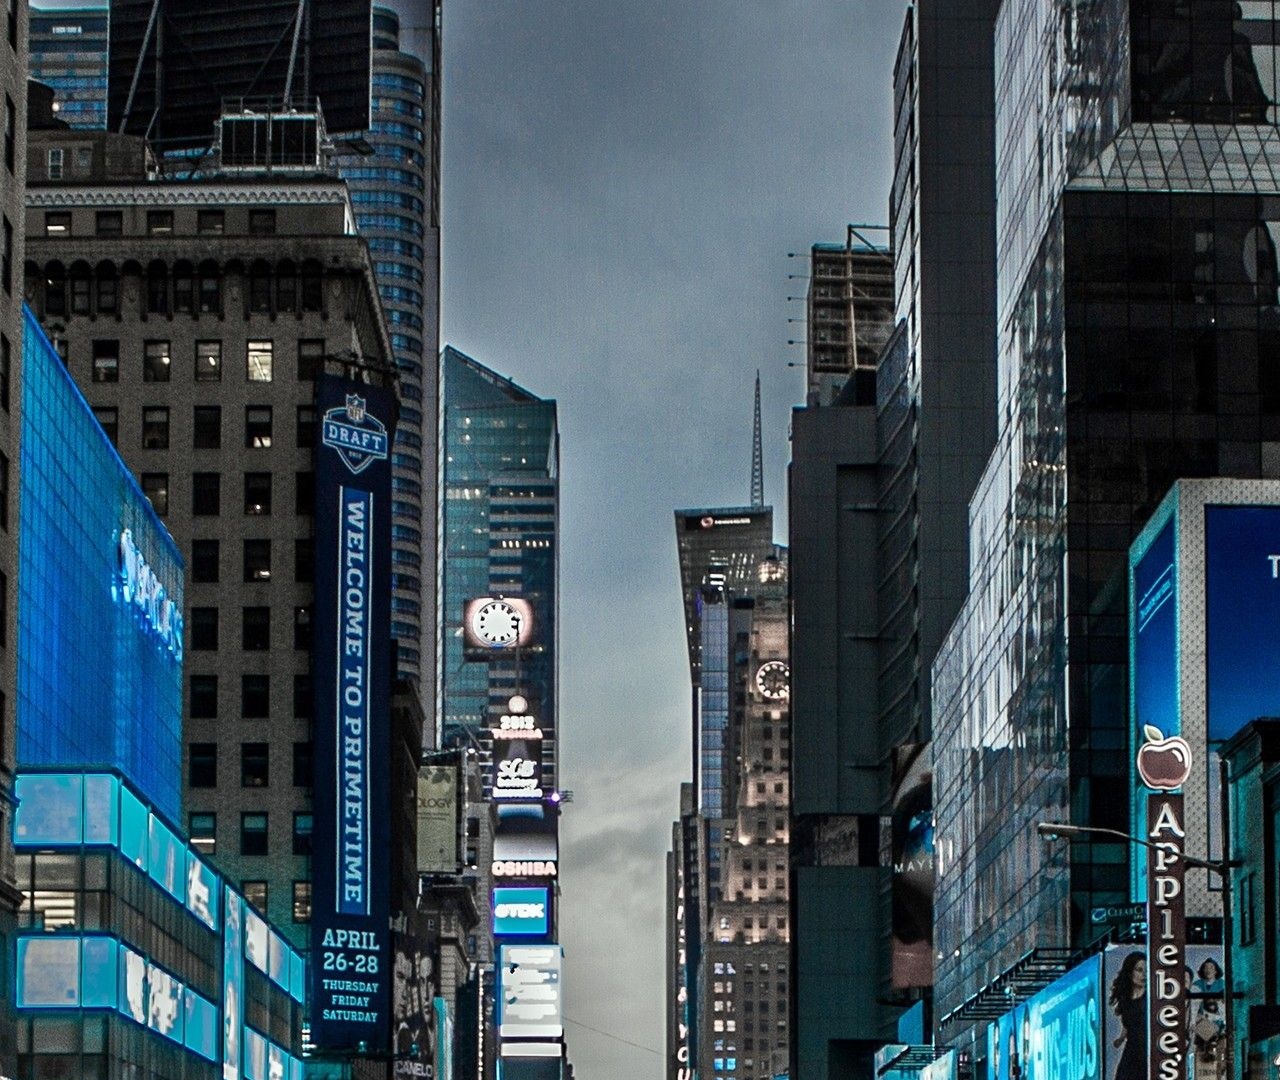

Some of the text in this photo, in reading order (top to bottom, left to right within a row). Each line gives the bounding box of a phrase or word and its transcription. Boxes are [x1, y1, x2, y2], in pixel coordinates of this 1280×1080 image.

[328, 424, 382, 449] DRAFT
[343, 500, 365, 904] WELCOME TO PRIMETIME
[322, 928, 380, 950] APRIL
[323, 952, 378, 974] 26-28
[322, 979, 380, 993] THURSDAY
[331, 994, 370, 1007] FRIDAY
[322, 1009, 378, 1023] SATURDAY
[395, 1059, 433, 1078] CANELO
